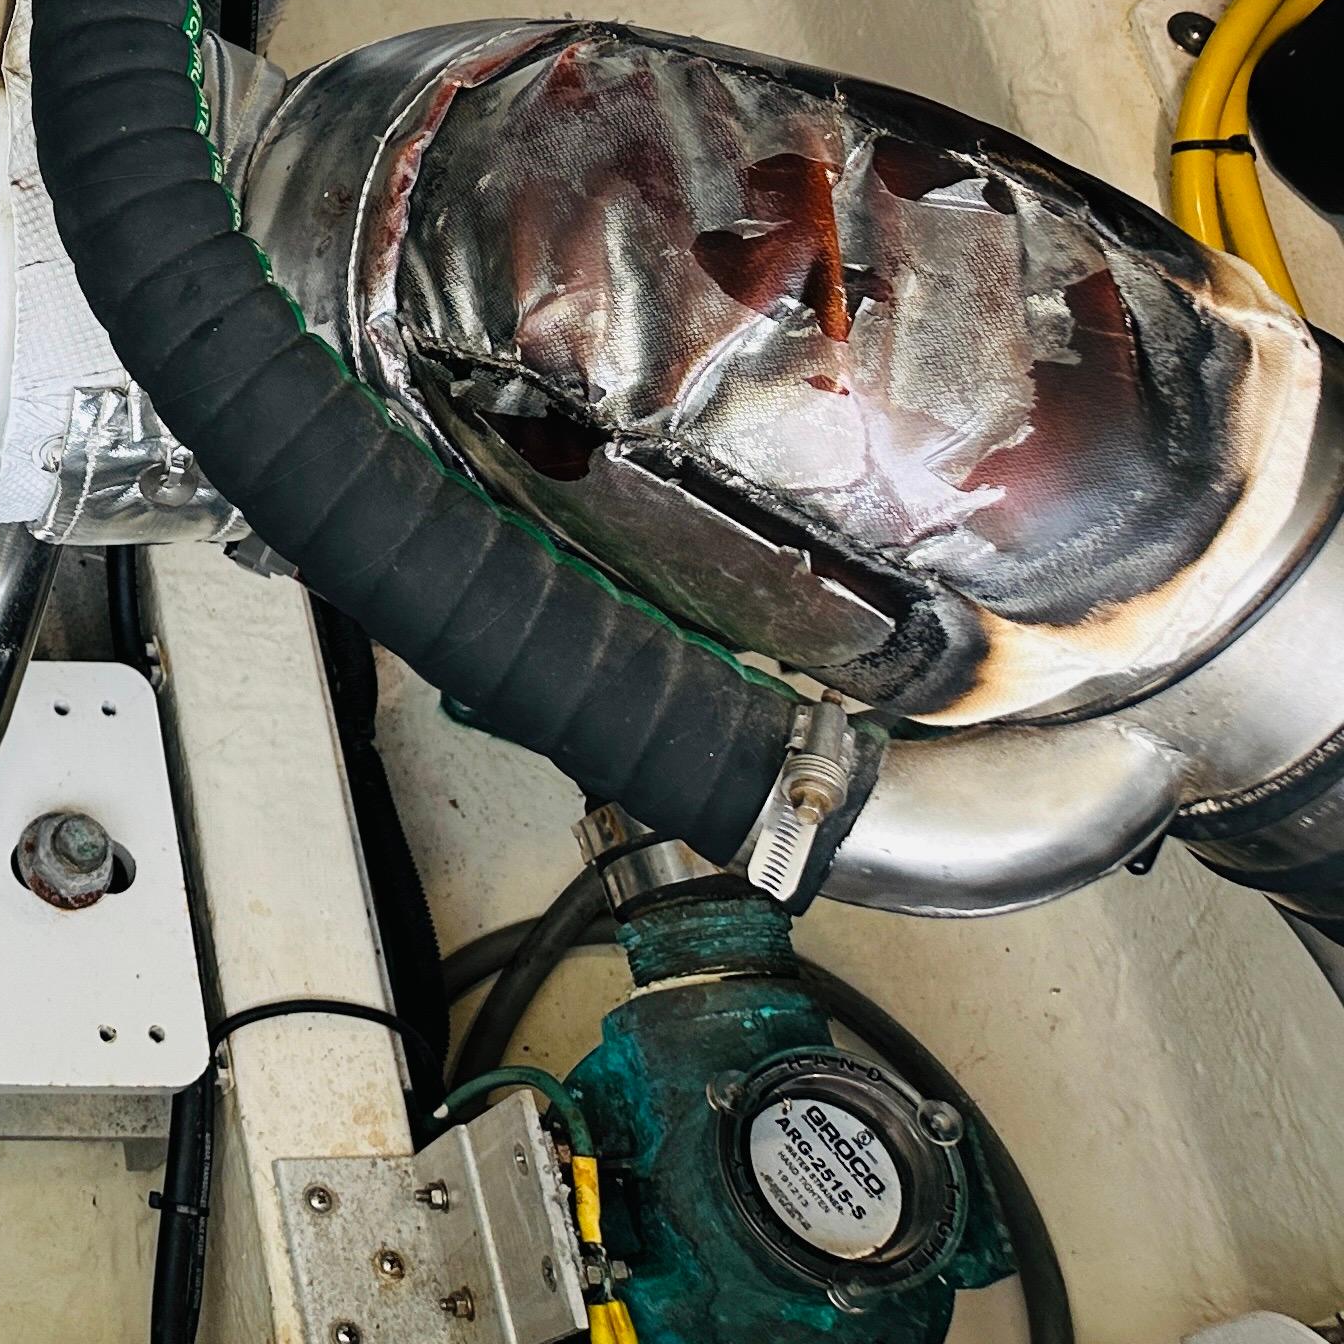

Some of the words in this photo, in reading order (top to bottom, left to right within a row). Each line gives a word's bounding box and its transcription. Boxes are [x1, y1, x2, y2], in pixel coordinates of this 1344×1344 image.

[774, 1113, 867, 1221] ARG-2515-S
[776, 1150, 800, 1177] HAND
[797, 1175, 831, 1214] TIGHTEN
[804, 1103, 887, 1197] GROCO
